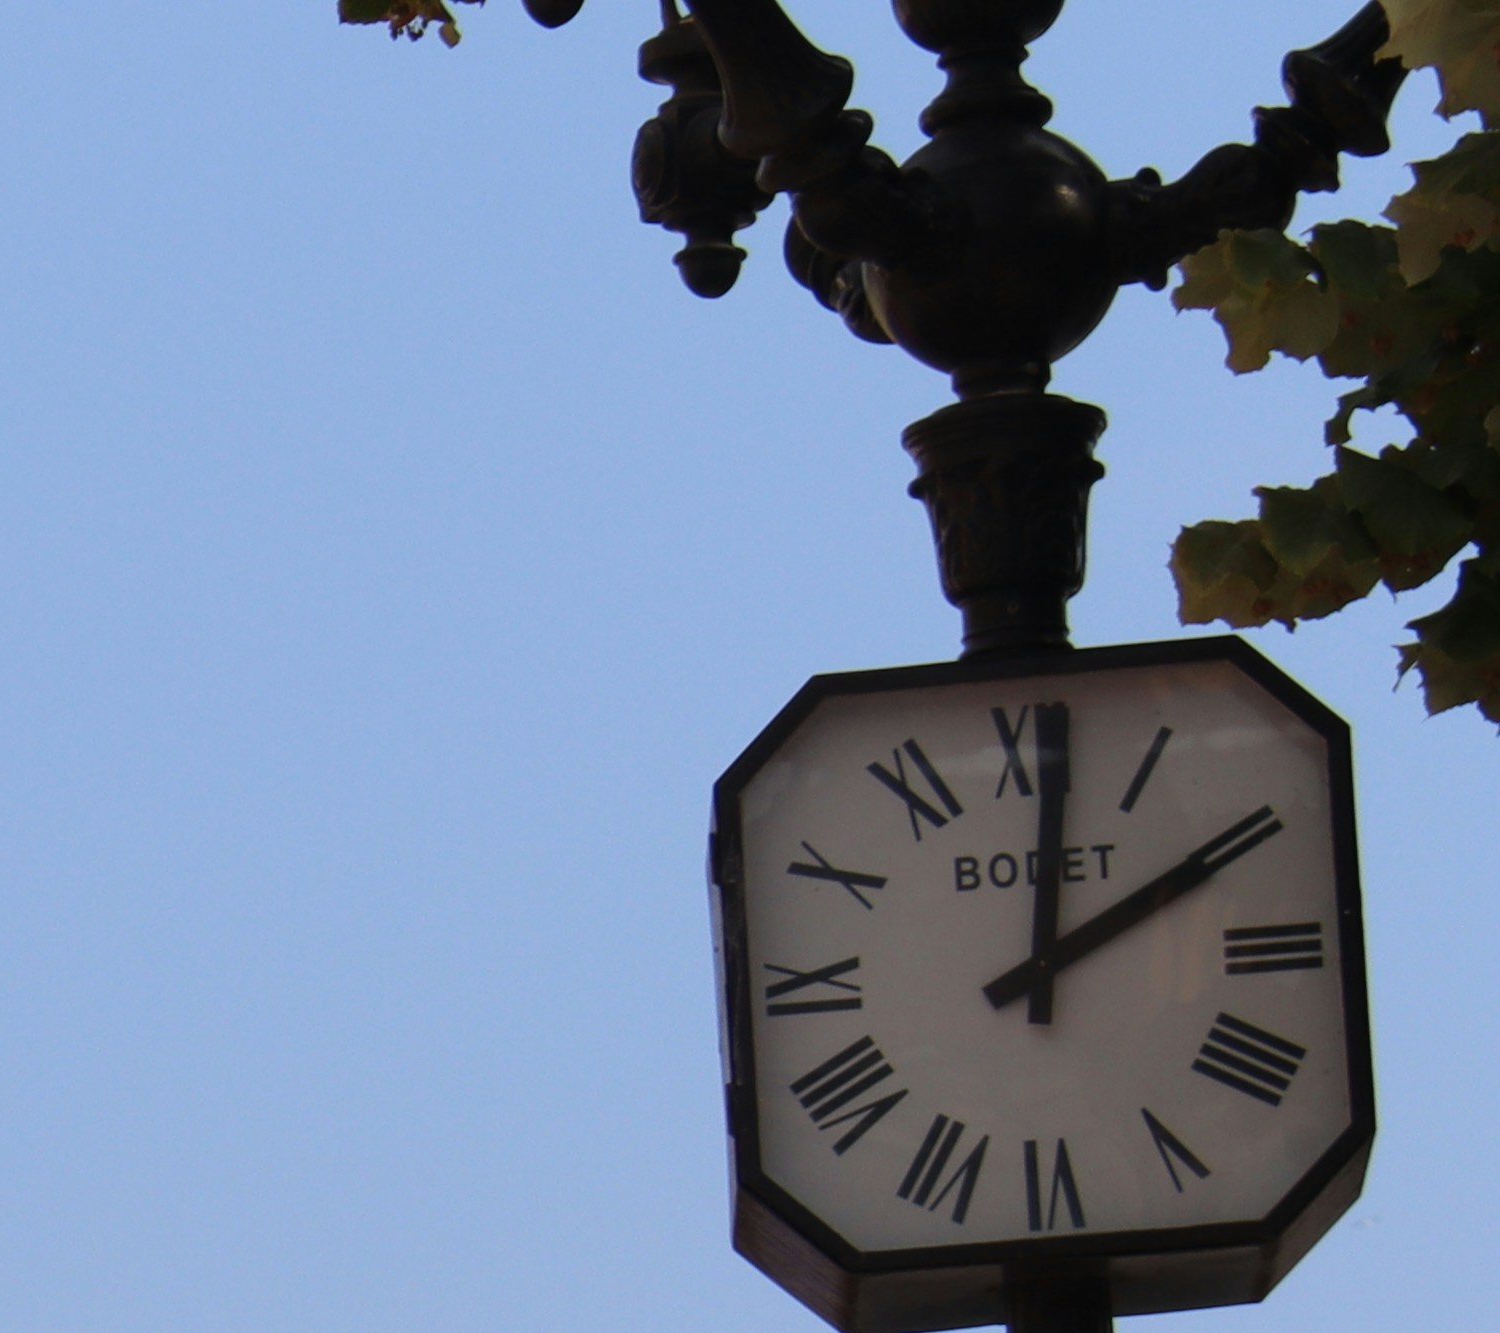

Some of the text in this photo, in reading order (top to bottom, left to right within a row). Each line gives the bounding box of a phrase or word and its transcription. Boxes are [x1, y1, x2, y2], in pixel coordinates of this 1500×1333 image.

[866, 737, 965, 842] XI
[786, 840, 888, 911] X
[763, 956, 862, 1017] IX
[1223, 922, 1323, 976] III
[788, 1034, 909, 1157] VIII
[896, 1112, 990, 1226] VII
[1023, 1137, 1086, 1232] VI
[1140, 1106, 1211, 1194] V
